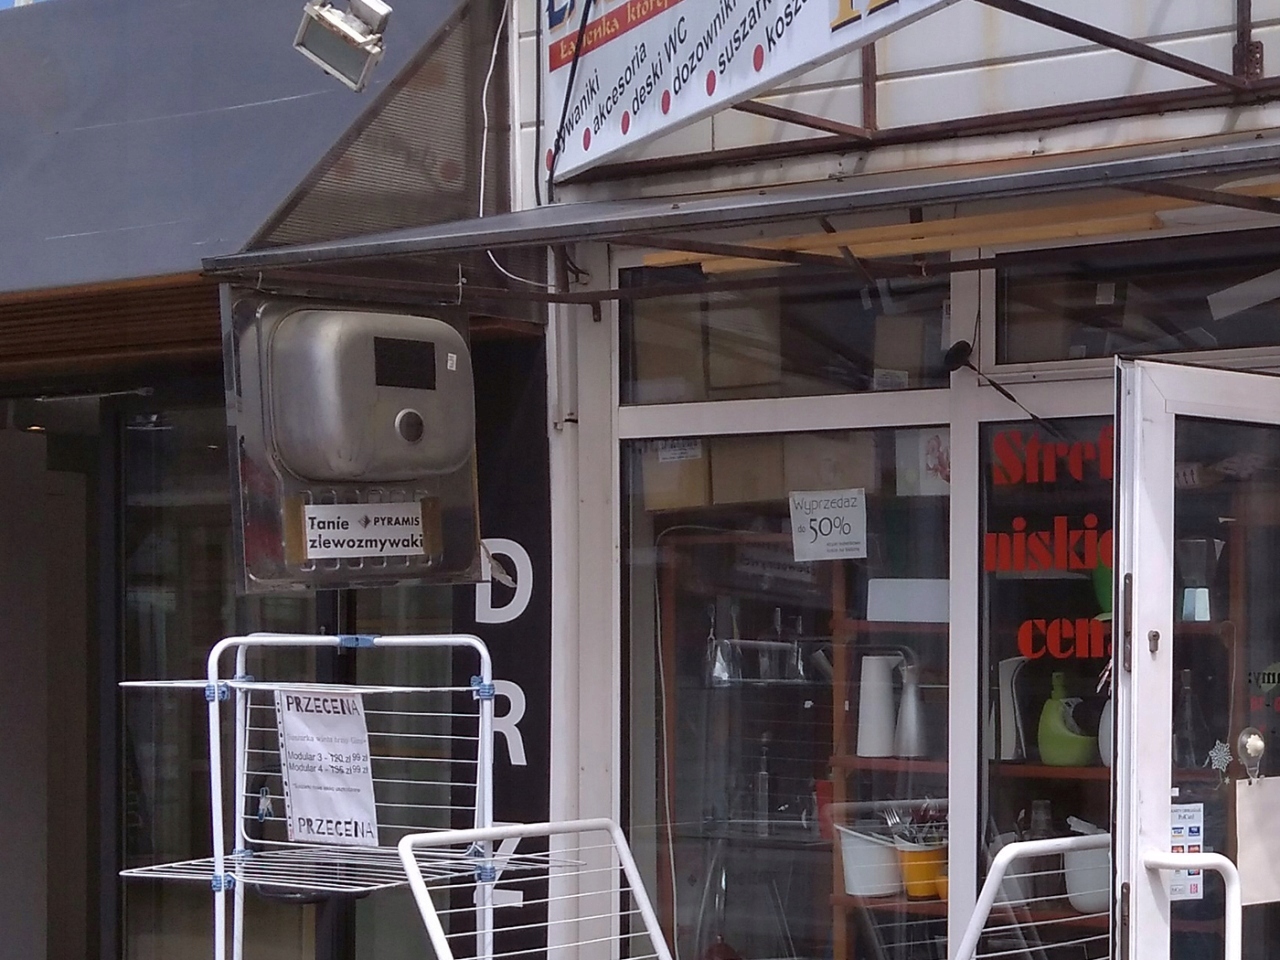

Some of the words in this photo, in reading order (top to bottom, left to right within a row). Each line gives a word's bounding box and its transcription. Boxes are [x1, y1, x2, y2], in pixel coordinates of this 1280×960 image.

[560, 17, 620, 60] Łaienka
[765, 0, 808, 52] kosz
[632, 51, 664, 116] deski
[664, 16, 688, 63] WC
[593, 42, 648, 135] akcesoria
[554, 67, 600, 154] ywaniki
[308, 516, 350, 530] Tanie
[373, 516, 420, 526] PYRAMIS
[809, 516, 852, 544] 50%
[309, 533, 423, 552] zlewozmywaki
[984, 513, 1113, 572] niski
[1018, 618, 1113, 660] cen
[286, 695, 361, 716] PRZECENA
[288, 750, 315, 761] Modular
[317, 752, 323, 762] 3
[352, 753, 361, 761] 99
[289, 762, 316, 773] Modular
[317, 765, 323, 773] 4
[298, 817, 374, 838] PRZECENA
